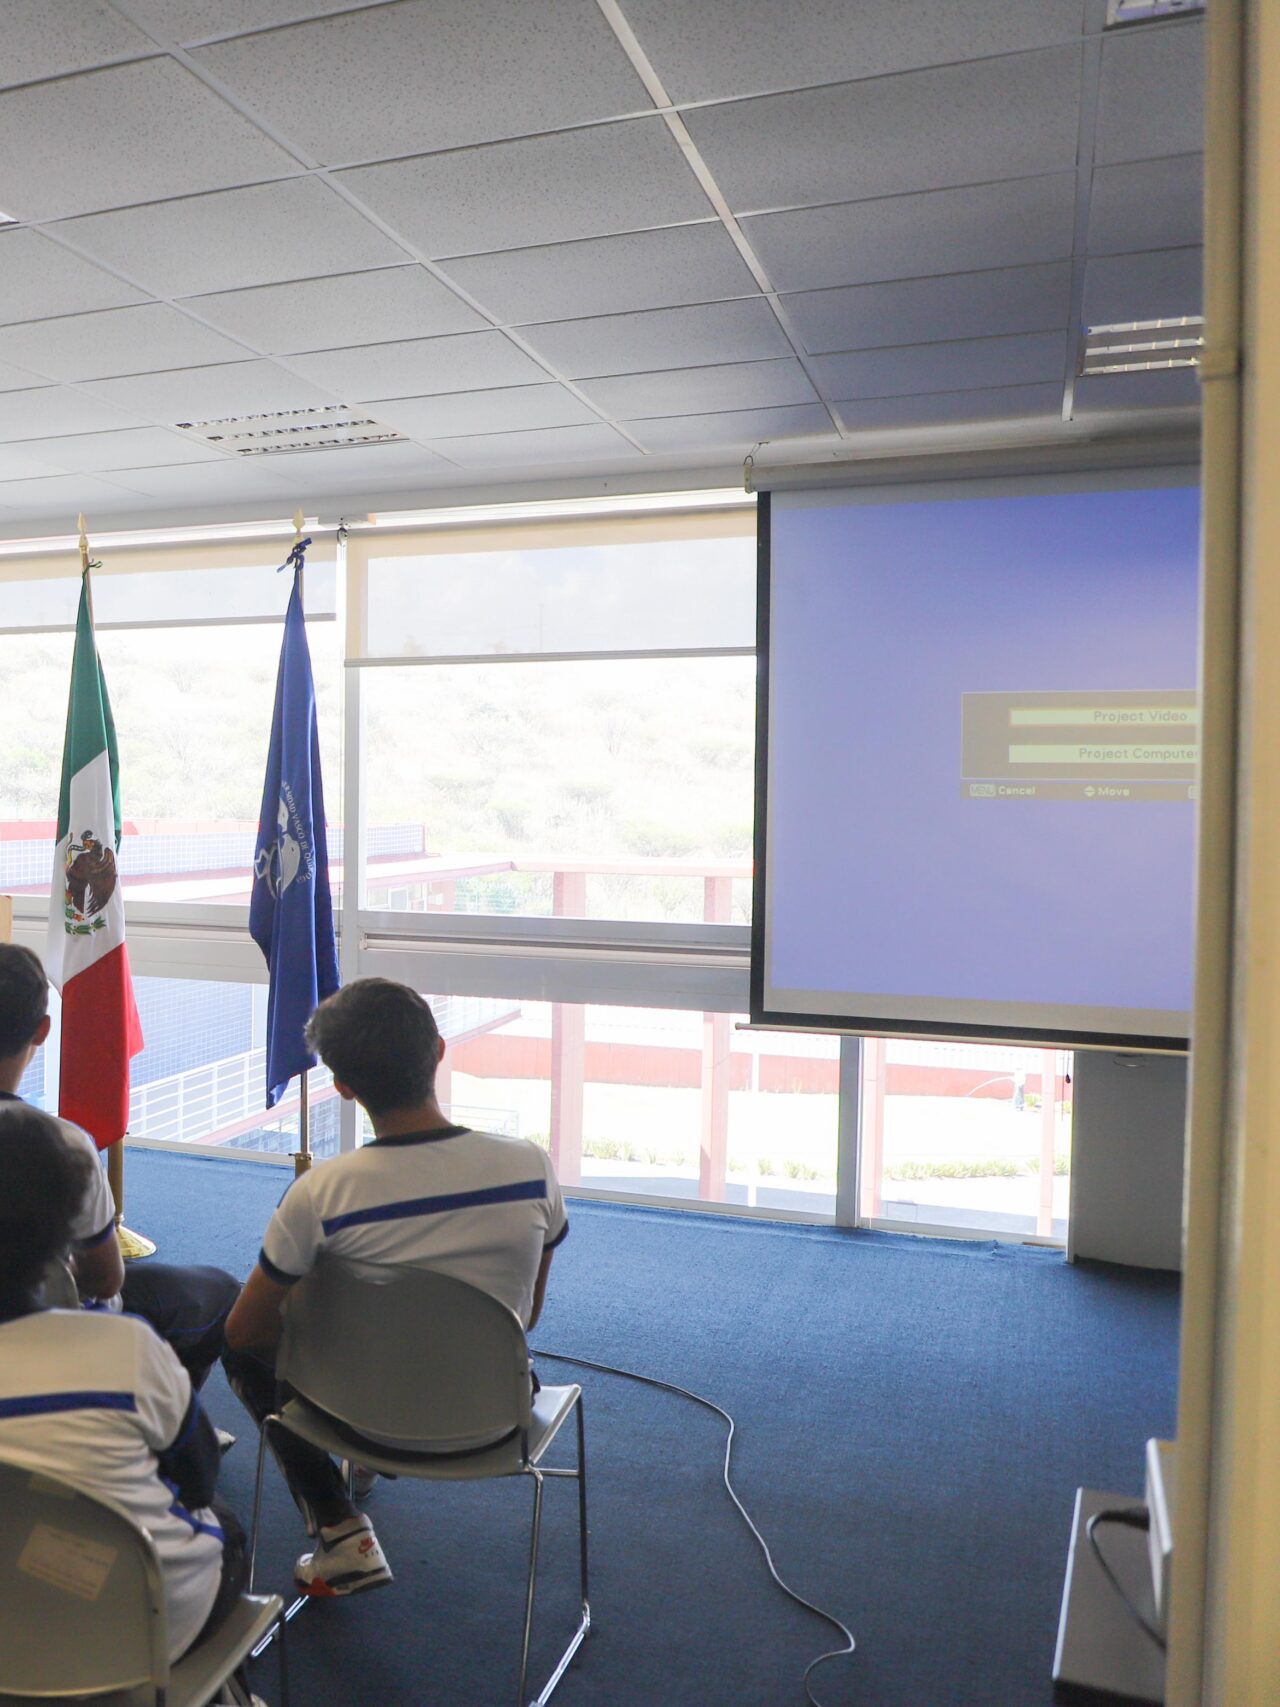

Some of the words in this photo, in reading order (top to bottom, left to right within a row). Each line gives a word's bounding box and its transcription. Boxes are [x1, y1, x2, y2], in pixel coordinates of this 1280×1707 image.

[1093, 710, 1144, 724] Project
[1148, 710, 1188, 722] Video
[1079, 747, 1129, 761] Project
[998, 785, 1036, 796] Cancel
[1097, 786, 1130, 797] Move
